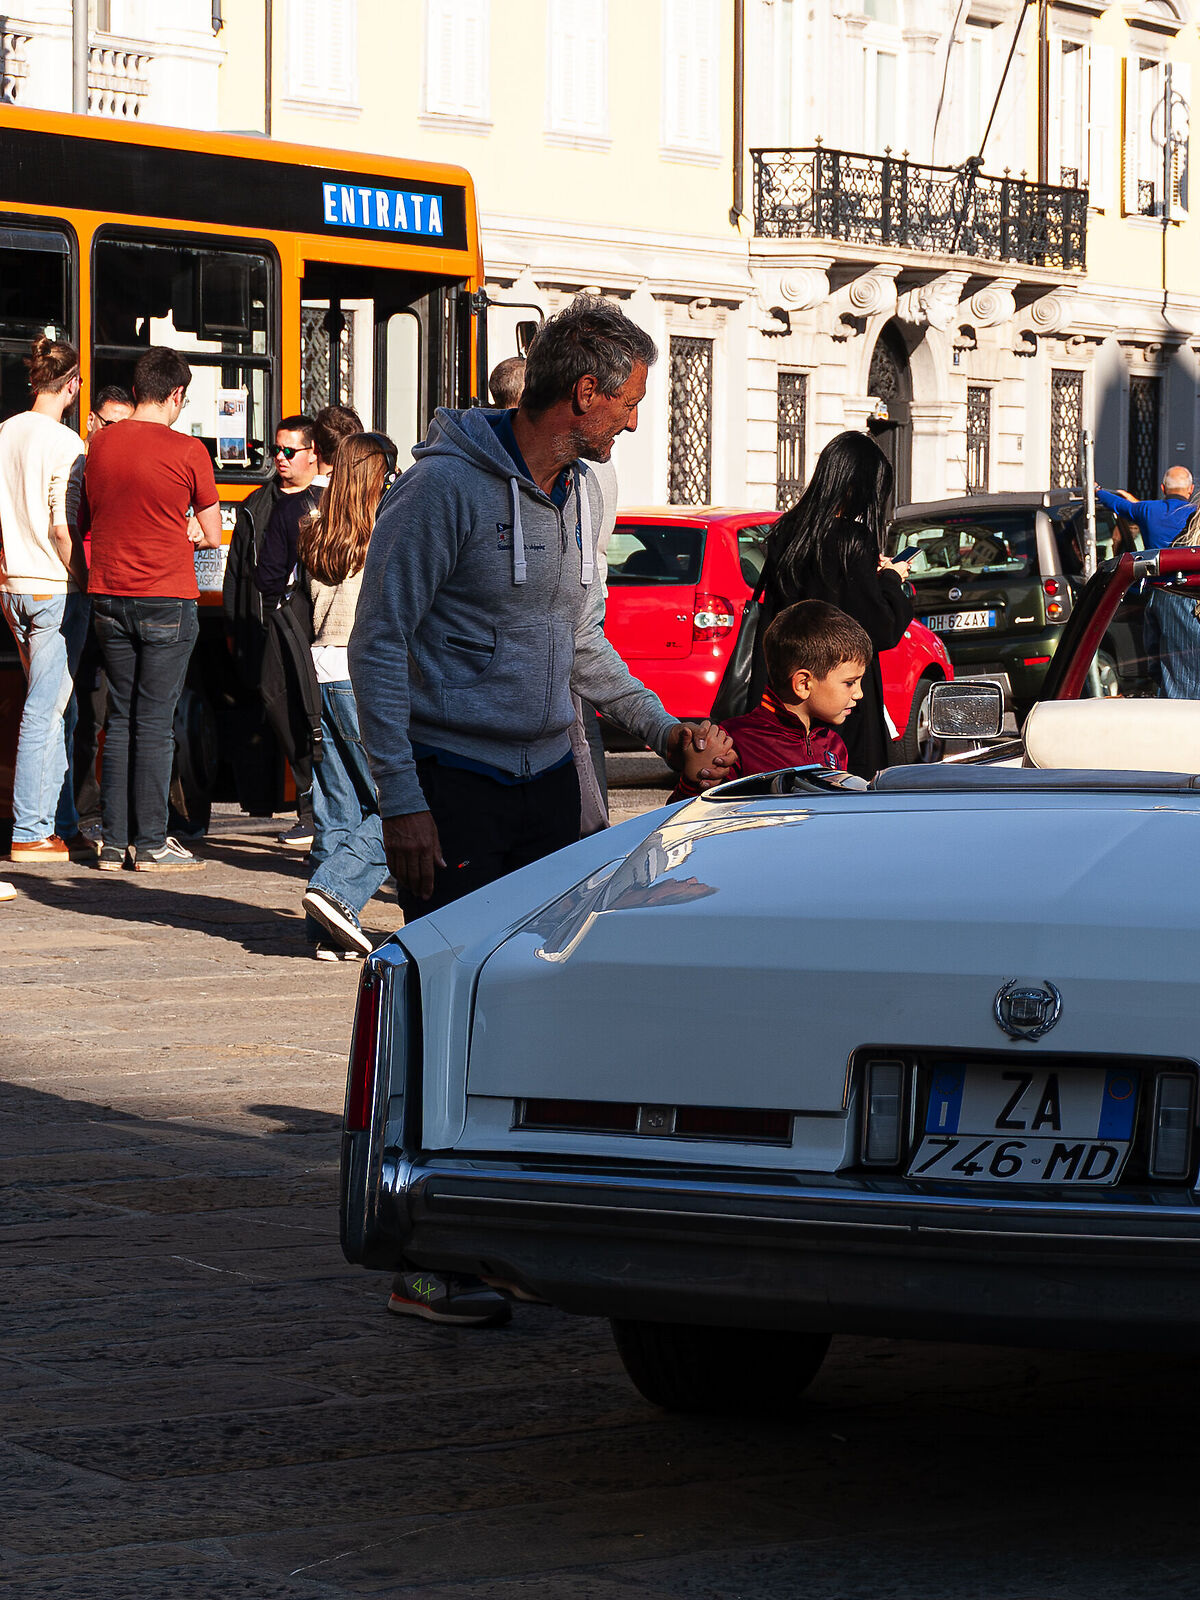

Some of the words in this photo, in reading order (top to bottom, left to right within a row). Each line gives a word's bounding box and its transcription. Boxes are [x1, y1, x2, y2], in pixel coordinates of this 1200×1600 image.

[324, 184, 442, 233] ENTRATA
[194, 561, 223, 573] SORZIAL
[197, 549, 227, 560] AZIEND
[929, 616, 944, 630] DH
[948, 612, 987, 628] 624AX
[995, 1071, 1062, 1131] ZA
[914, 1138, 1028, 1179] 746
[1041, 1142, 1120, 1181] MD
